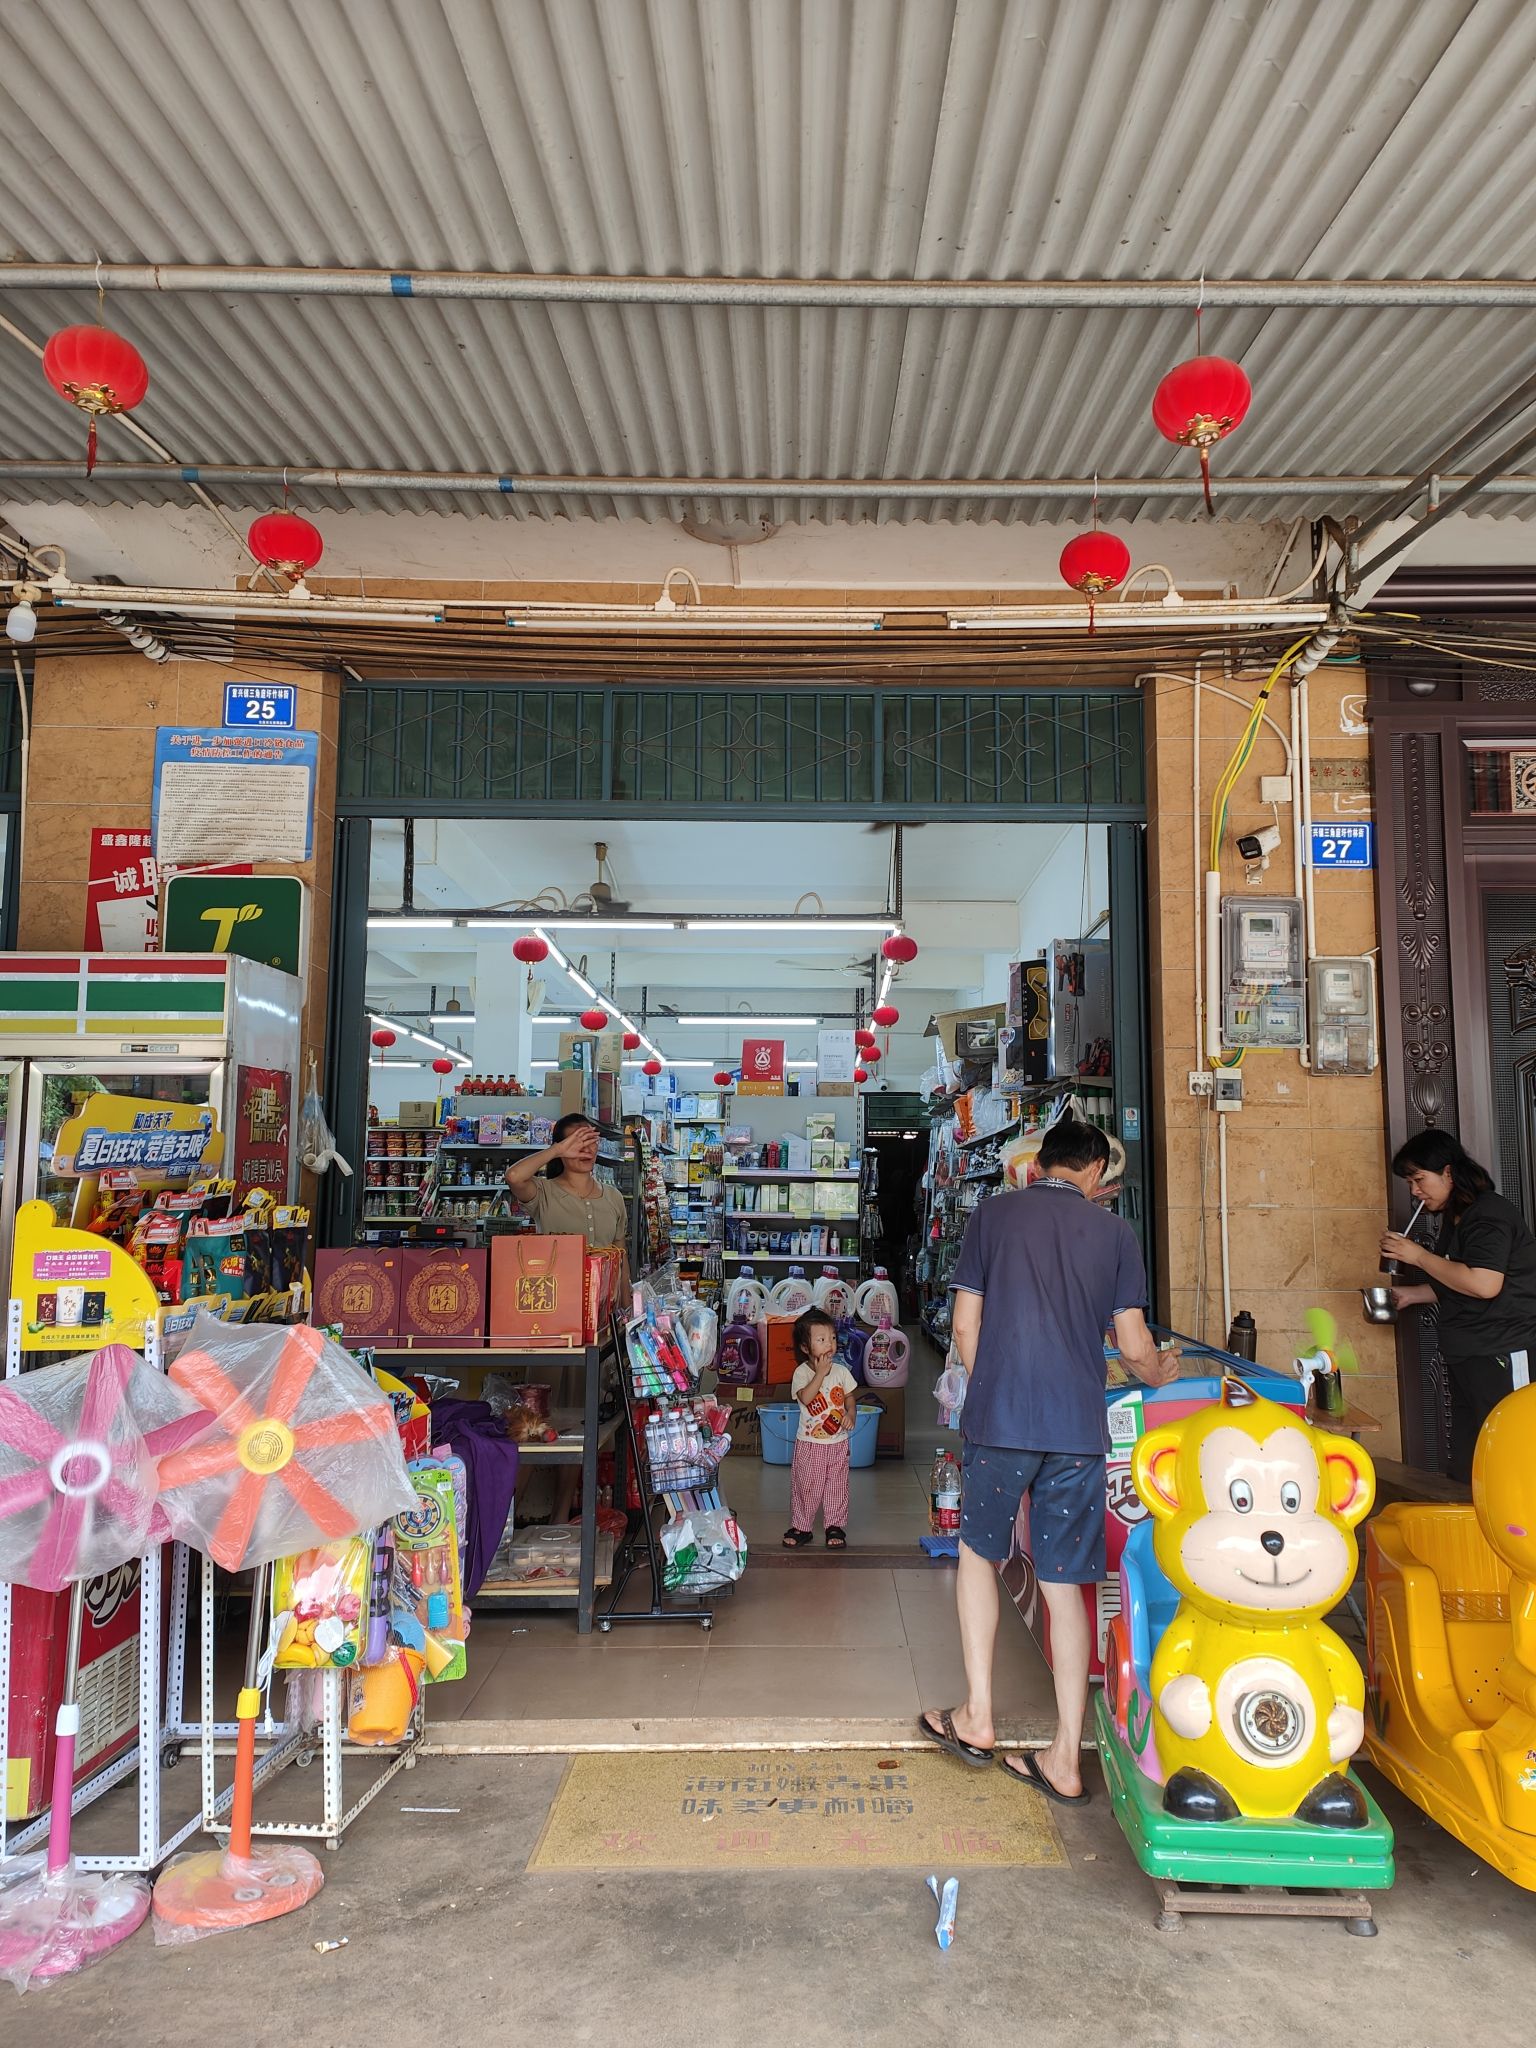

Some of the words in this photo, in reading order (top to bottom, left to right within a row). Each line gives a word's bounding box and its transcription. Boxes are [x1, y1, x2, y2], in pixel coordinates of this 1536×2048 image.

[245, 700, 275, 719] 25
[170, 735, 305, 748] 关于进一步加强进口冷链食品
[190, 747, 283, 760] 疫情防控工作的通告
[1311, 827, 1364, 838] 兴镇三角庭圩竹林街
[1321, 839, 1352, 859] 27
[132, 1112, 174, 1130] 和成天下
[78, 1134, 146, 1166] 夏日狂欢
[145, 1133, 206, 1162] 爱意无限
[600, 1828, 1002, 1855] 欢迎光临
